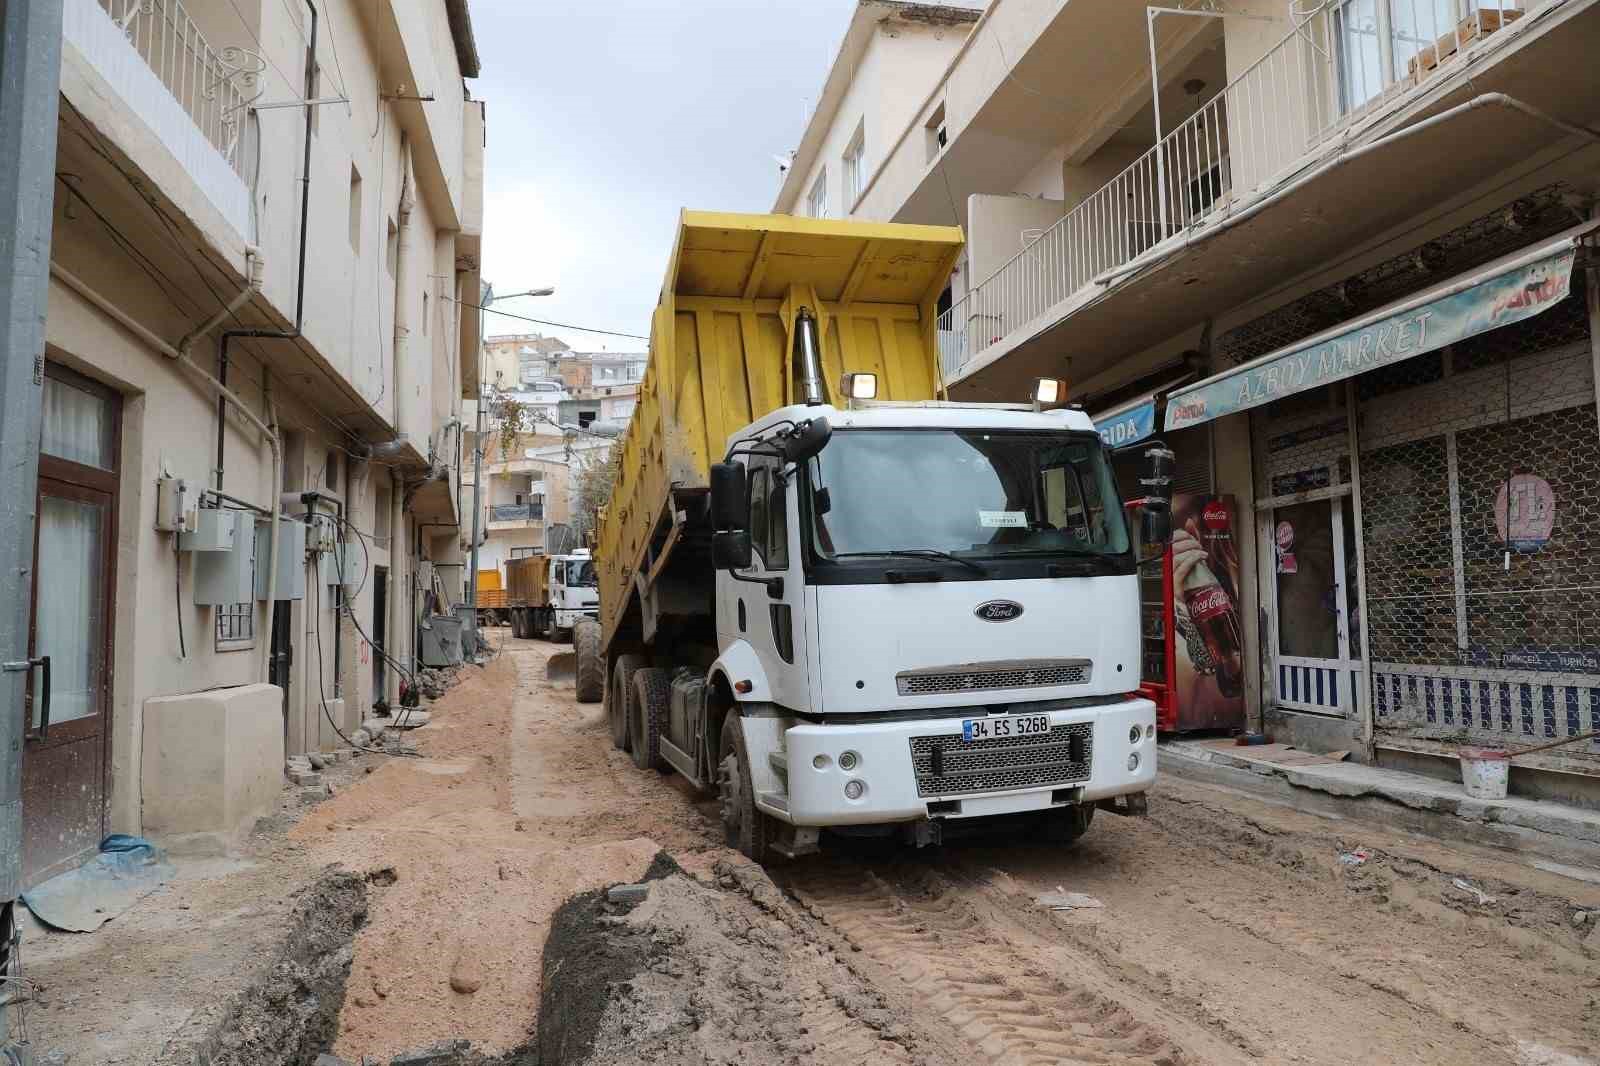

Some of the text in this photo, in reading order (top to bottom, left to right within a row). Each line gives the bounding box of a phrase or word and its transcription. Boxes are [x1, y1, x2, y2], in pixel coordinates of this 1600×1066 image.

[1318, 311, 1433, 380] MARKET
[972, 720, 988, 738] 34
[994, 719, 1010, 736] ES
[1016, 716, 1048, 734] 5268
